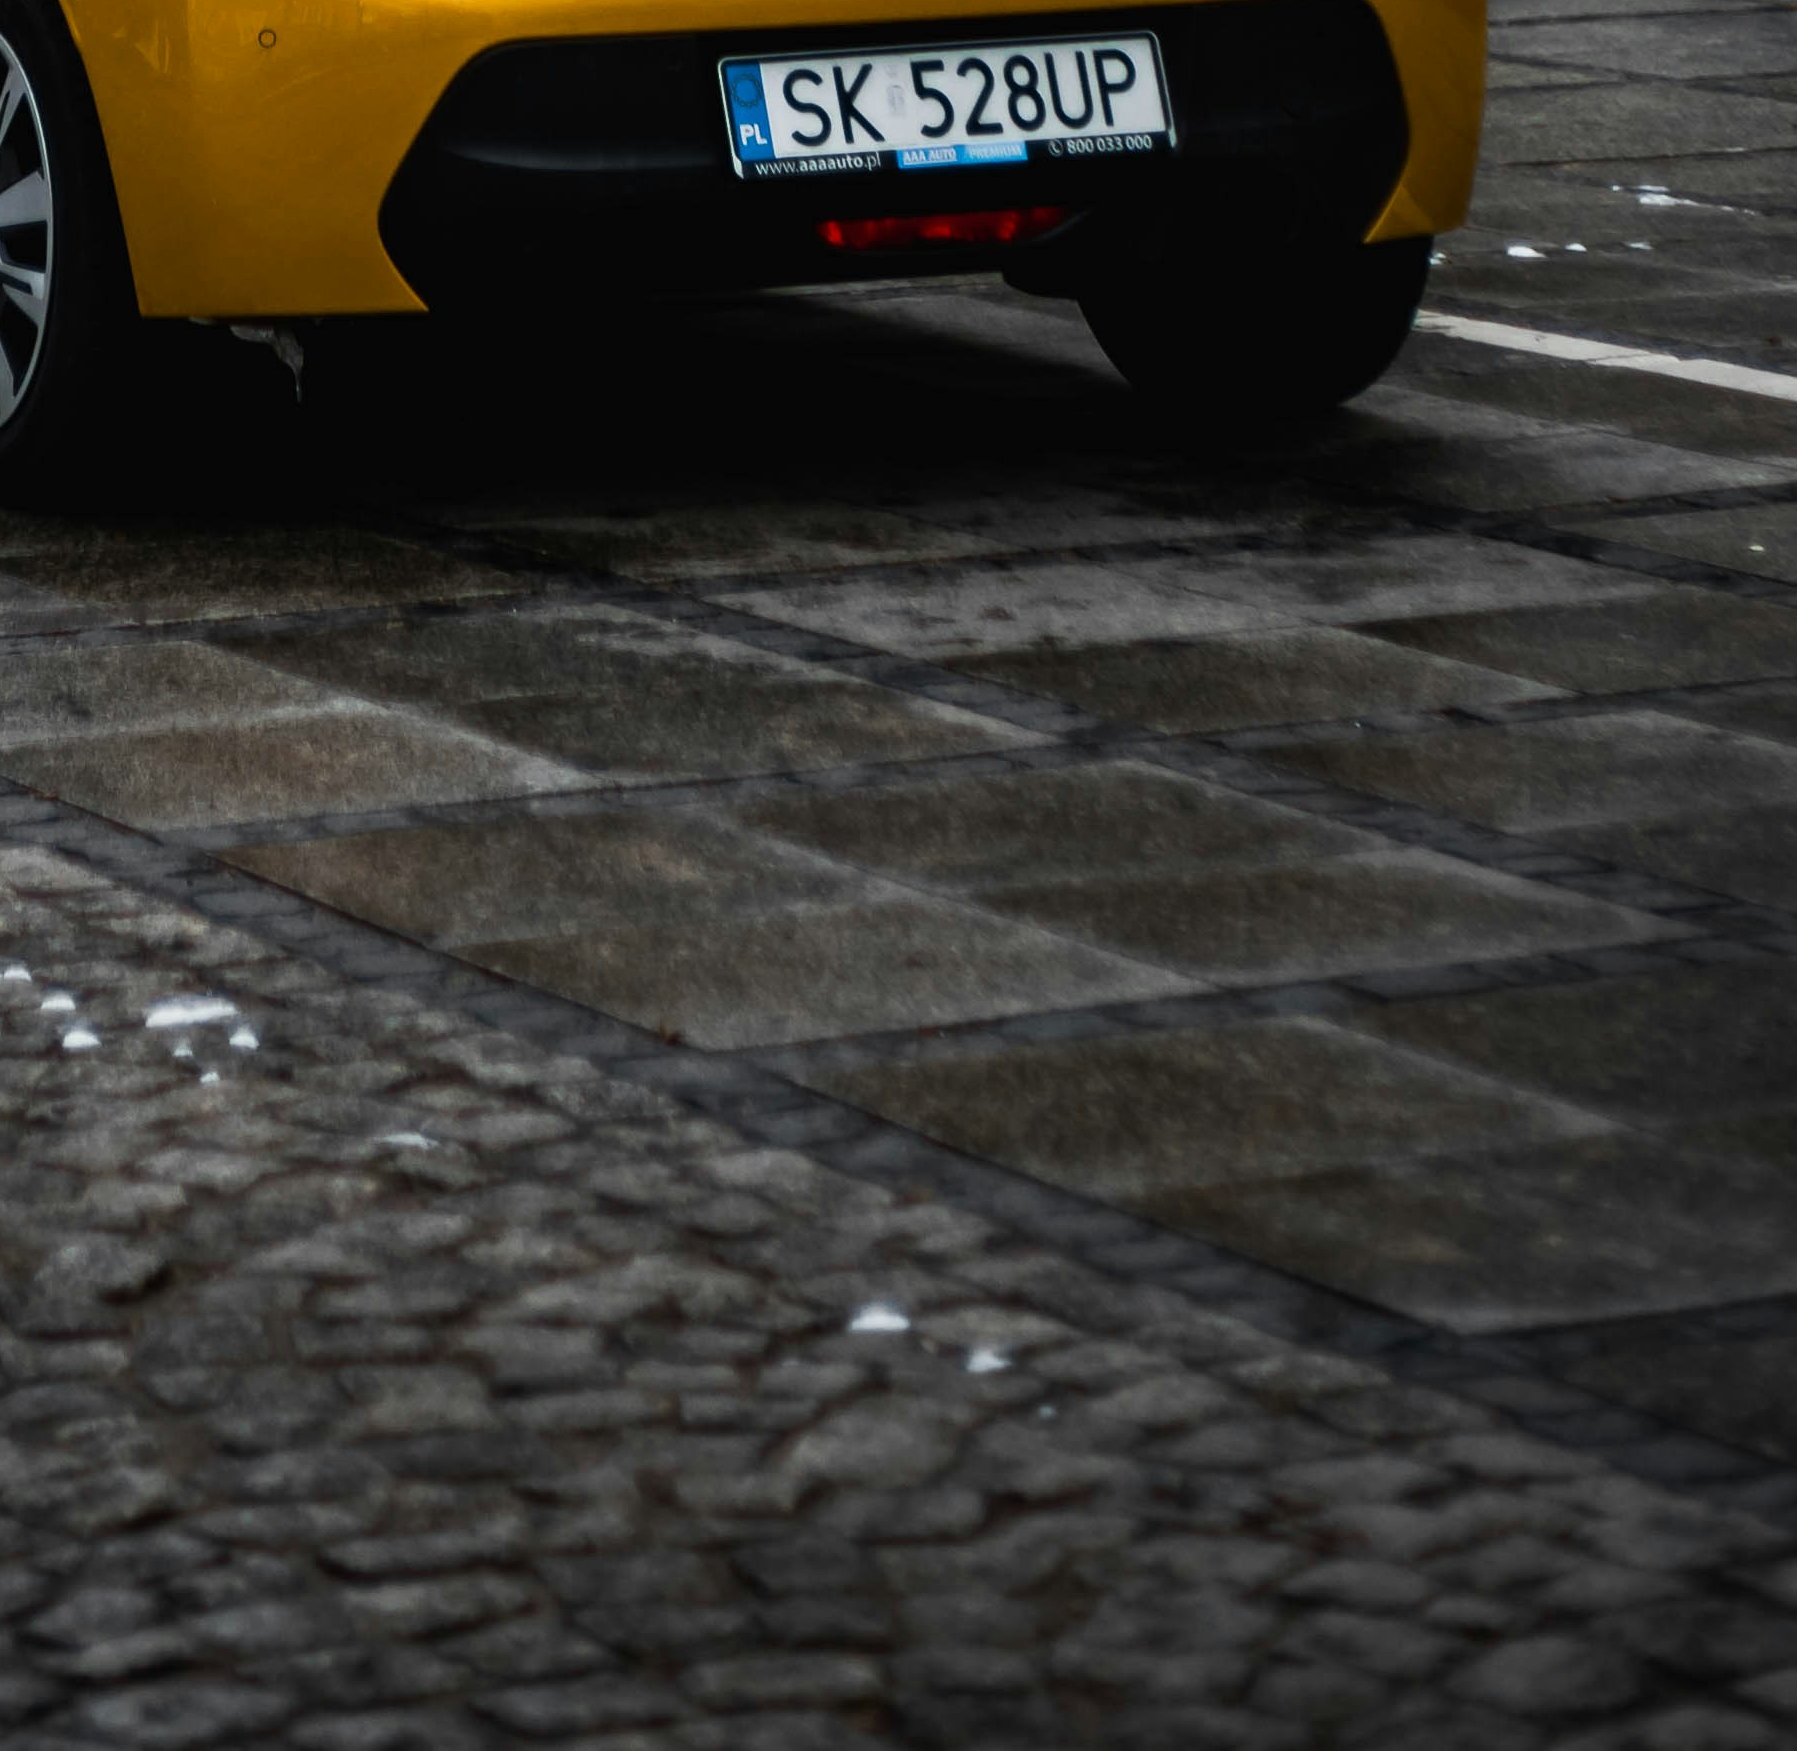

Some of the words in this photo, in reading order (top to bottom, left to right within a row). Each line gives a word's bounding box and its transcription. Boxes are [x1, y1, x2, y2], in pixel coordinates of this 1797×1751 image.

[783, 63, 885, 147] SK
[910, 49, 1136, 137] 528UP
[740, 124, 768, 146] PL
[1067, 138, 1094, 154] 800
[1097, 136, 1124, 152] 033
[1125, 134, 1152, 150] 000
[755, 151, 882, 176] www.aaaauto.pl
